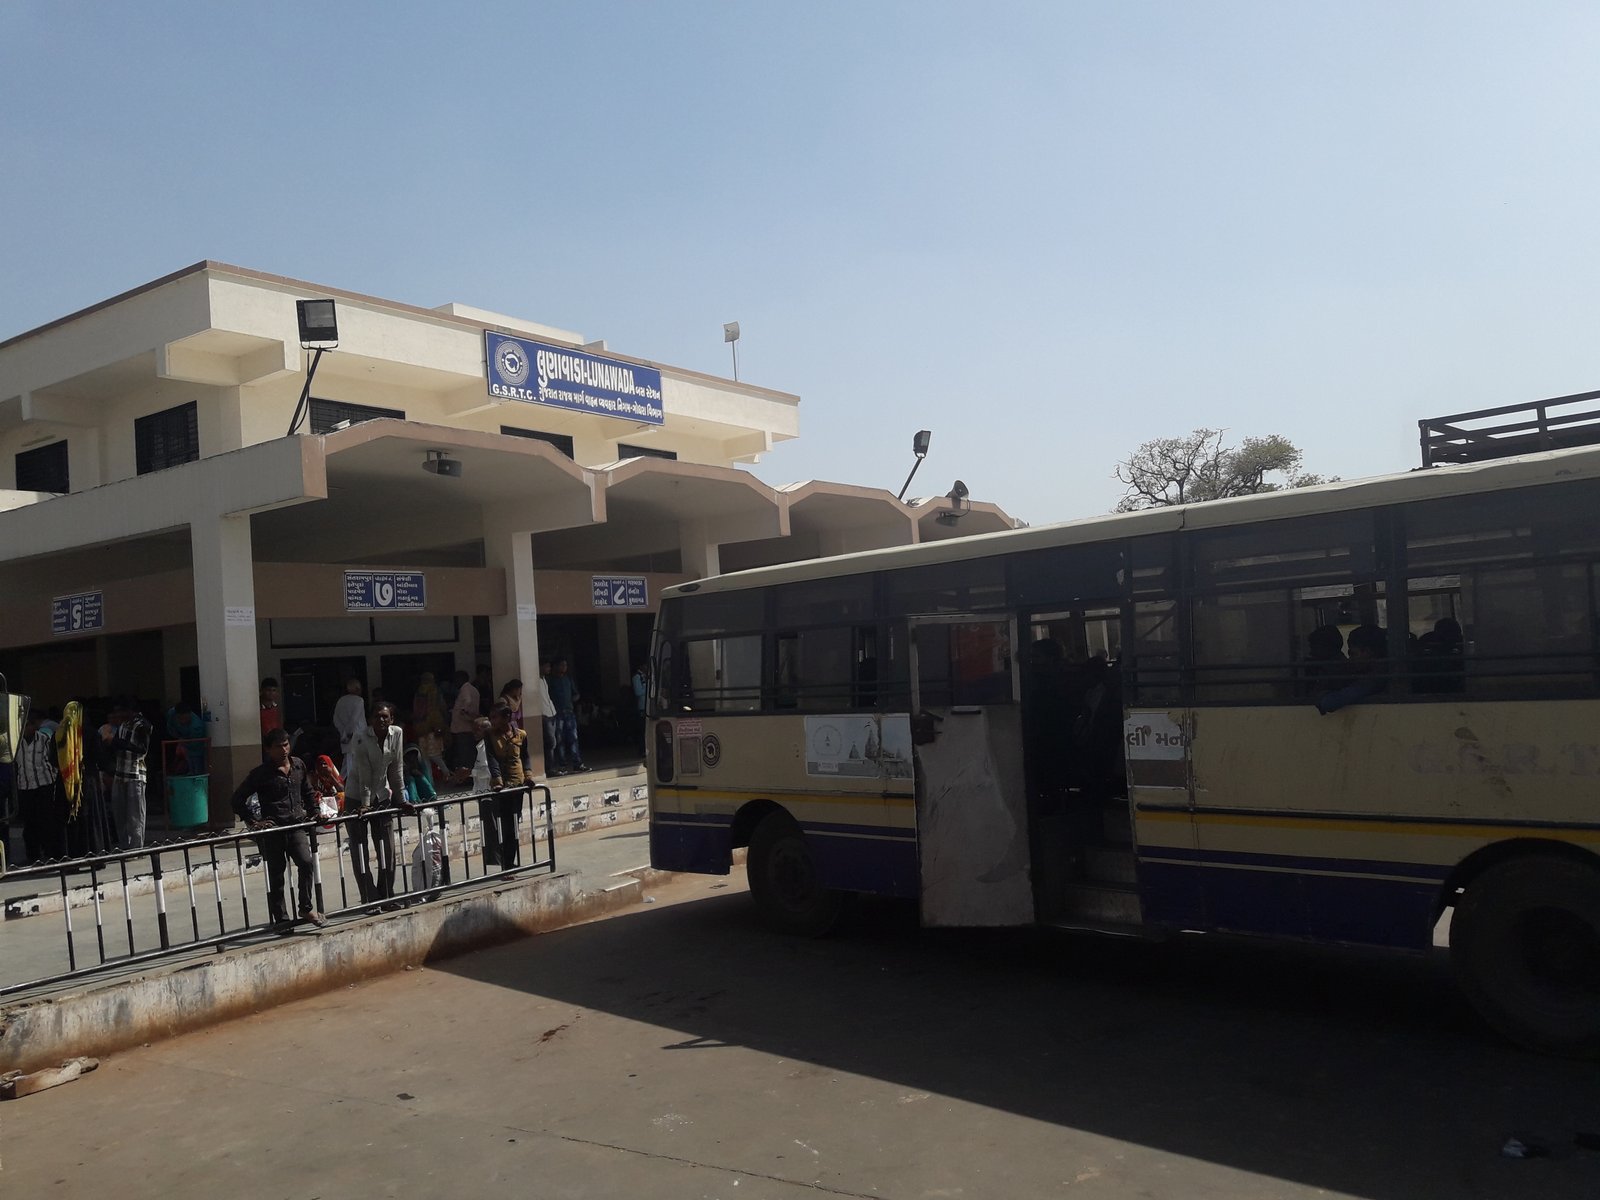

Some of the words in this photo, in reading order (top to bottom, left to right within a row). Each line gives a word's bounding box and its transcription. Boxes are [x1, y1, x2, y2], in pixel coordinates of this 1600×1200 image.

[492, 384, 536, 402] G.S.R.T.C.
[539, 386, 557, 401] ગુજરાત
[375, 582, 393, 606] ૭
[613, 585, 626, 605] ૮
[72, 604, 82, 629] ૬
